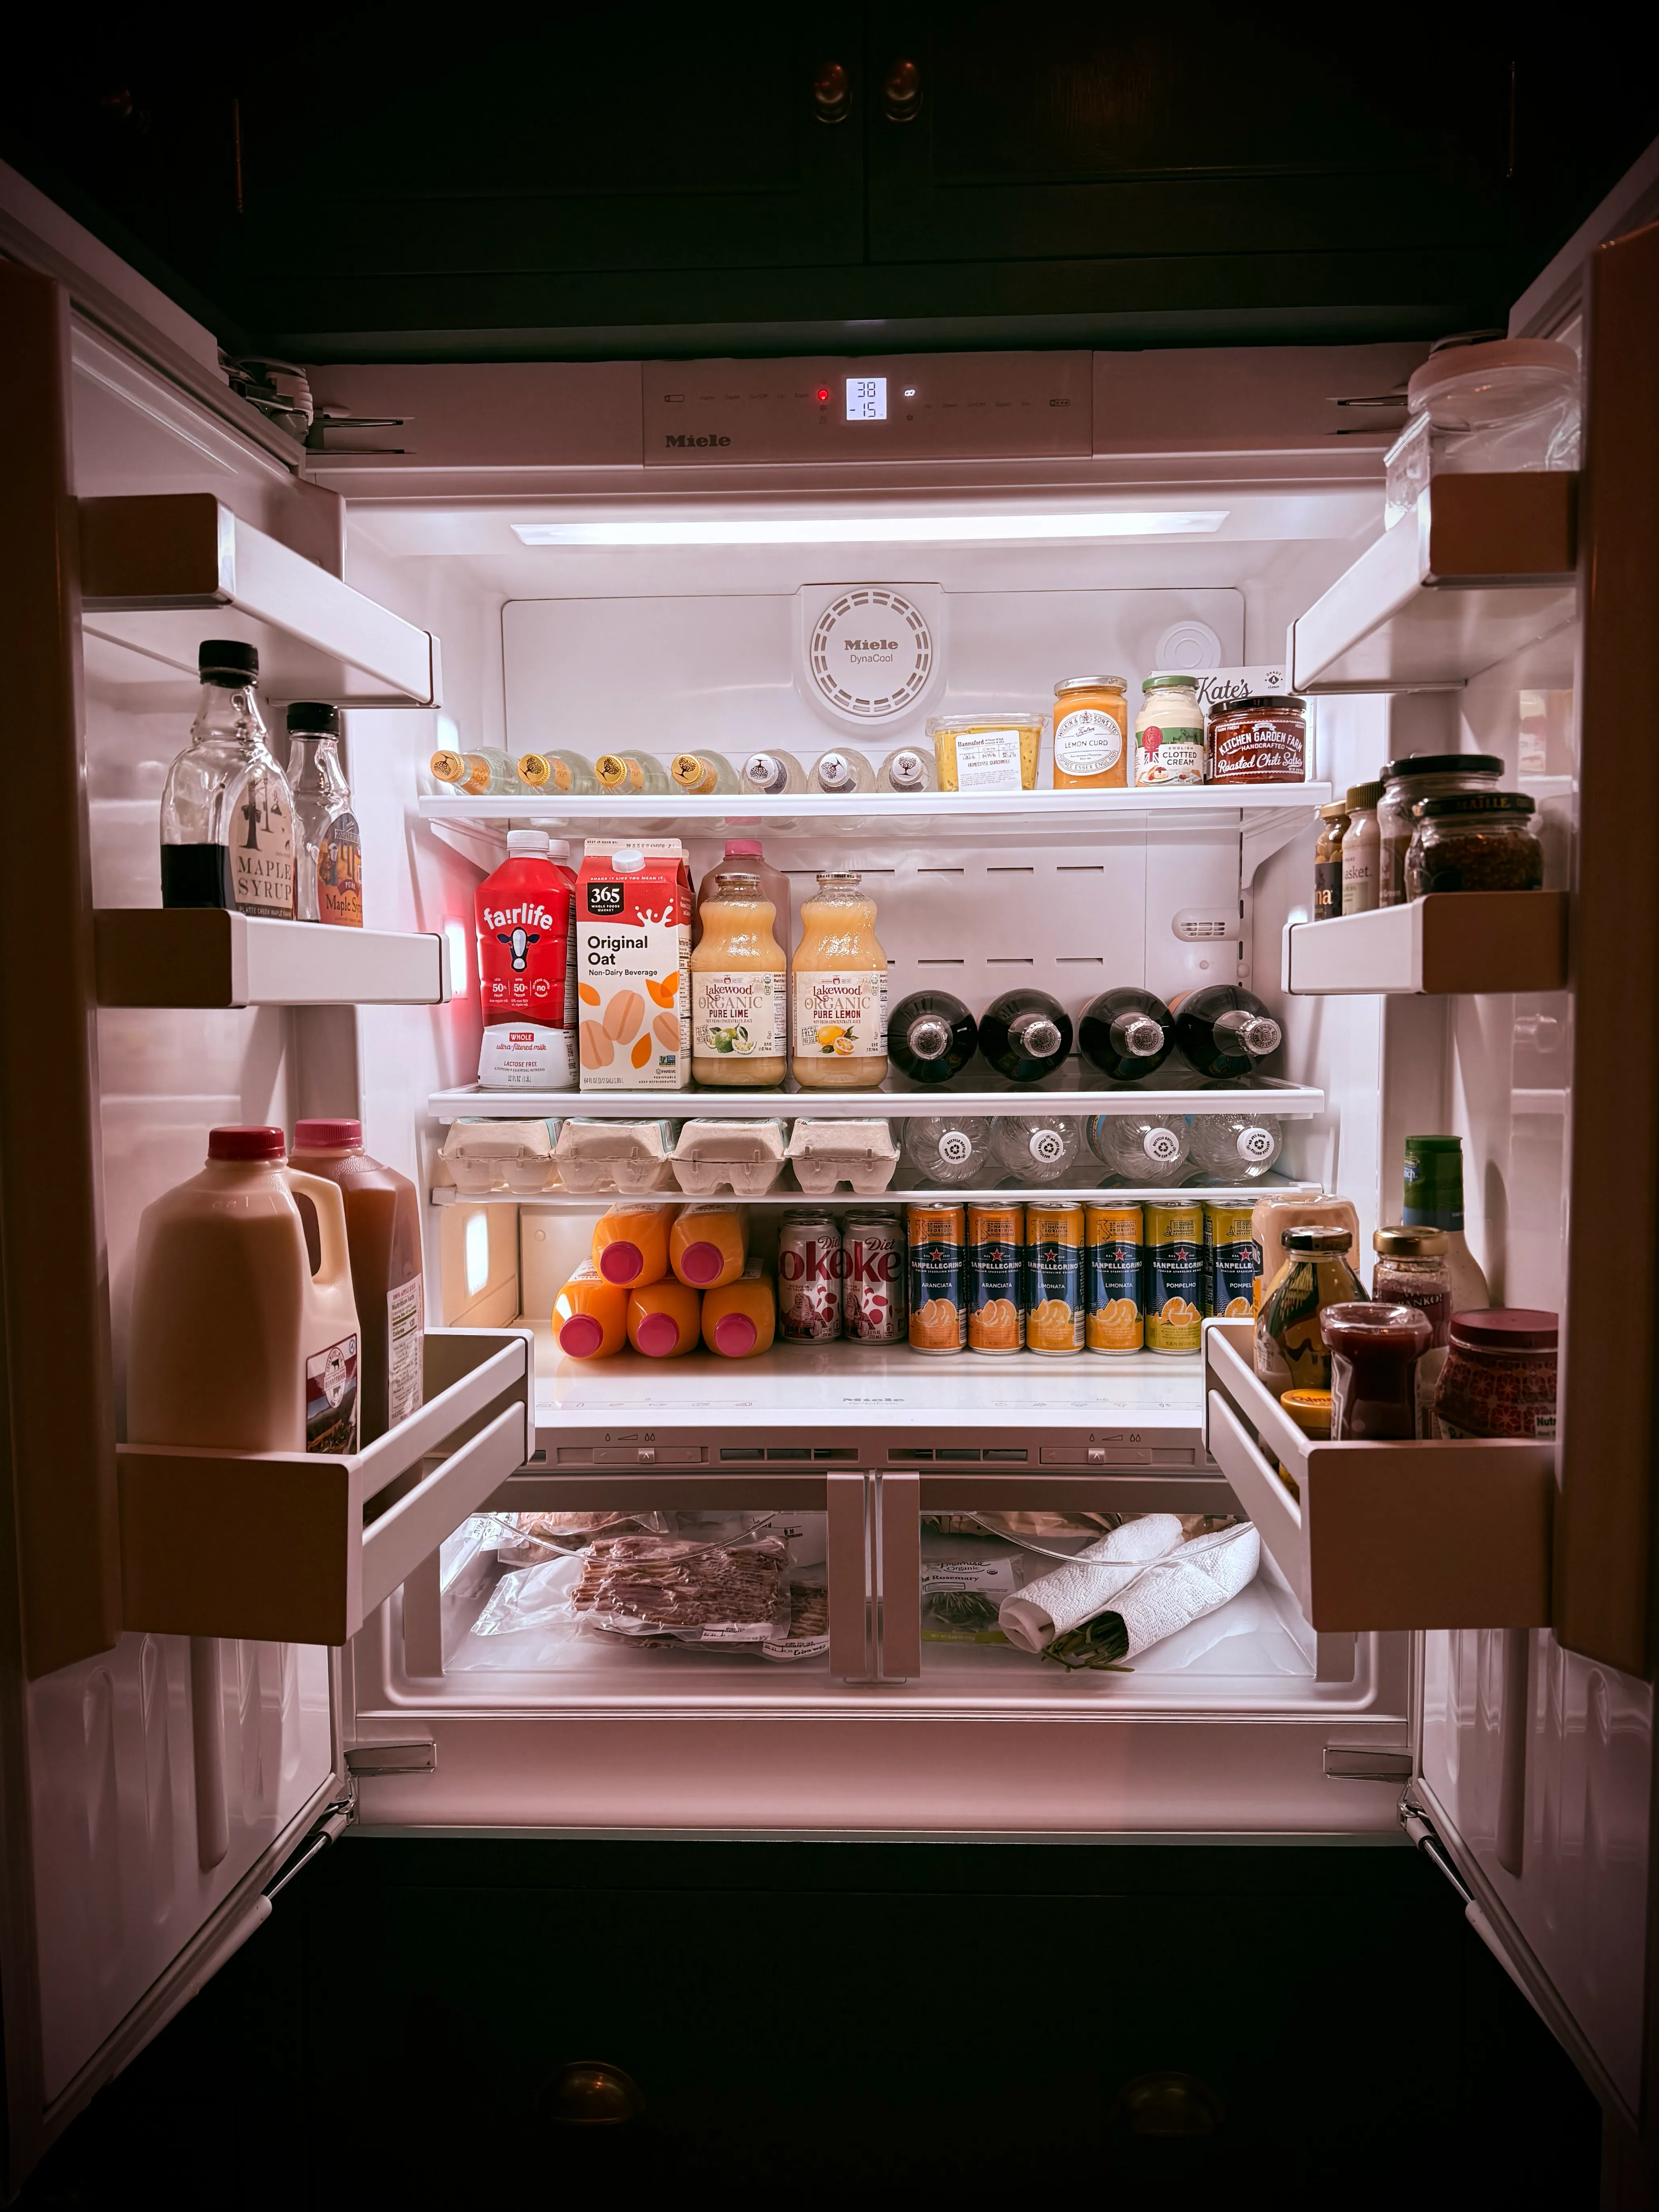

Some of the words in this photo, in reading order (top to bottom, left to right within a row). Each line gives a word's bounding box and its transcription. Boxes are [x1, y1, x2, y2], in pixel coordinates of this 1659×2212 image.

[857, 382, 875, 398] 38
[849, 402, 876, 418] -15
[665, 435, 731, 448] Miele
[844, 640, 898, 650] Miele
[850, 654, 893, 664] DynaCool
[1197, 677, 1252, 704] Kate's
[1059, 720, 1072, 737] WILKIN
[1094, 717, 1109, 725] SONS
[1109, 723, 1117, 734] LTD
[1218, 733, 1251, 756] KITCHEN
[1254, 731, 1286, 742] GARDEN
[1287, 734, 1302, 752] FARM
[1241, 743, 1285, 752] HANDCRAFTED
[1095, 752, 1117, 768] ENGLAND
[1218, 754, 1256, 773] Roasted
[1257, 752, 1281, 768] Chili
[1282, 752, 1302, 768] Salsa
[237, 856, 291, 880] MAPLE
[238, 877, 291, 900] SYRUP
[345, 881, 355, 889] PURE
[591, 886, 620, 903] 365
[326, 894, 350, 916] Maple
[587, 935, 647, 952] Original
[588, 952, 616, 965] Oat
[706, 984, 752, 996] Lakewood
[813, 985, 860, 996] Lakewood
[699, 996, 762, 1008] ORGANIC
[805, 997, 870, 1010] ORGANIC
[709, 1010, 727, 1018] PURE
[731, 1009, 748, 1018] LIME
[836, 1010, 860, 1018] LEMON
[696, 1026, 708, 1037] FRESH
[802, 1027, 817, 1037] FRESH
[496, 1043, 532, 1051] ultra-filtered
[1038, 1138, 1046, 1149] BOTTLE
[1153, 1136, 1164, 1146] RECYCLE
[1165, 1137, 1174, 1146] BOTTLE
[1038, 1150, 1050, 1158] RECYCLE
[865, 1237, 896, 1251] Diet
[779, 1241, 842, 1282] oke
[843, 1241, 902, 1282] oke
[1028, 1261, 1078, 1270] SANPELLEGRINO
[1153, 1261, 1203, 1269] SANPELLEGRINO
[392, 1298, 407, 1311] Nutrition
[1398, 1294, 1443, 1307] ANKO!
[392, 1327, 405, 1337] Calories
